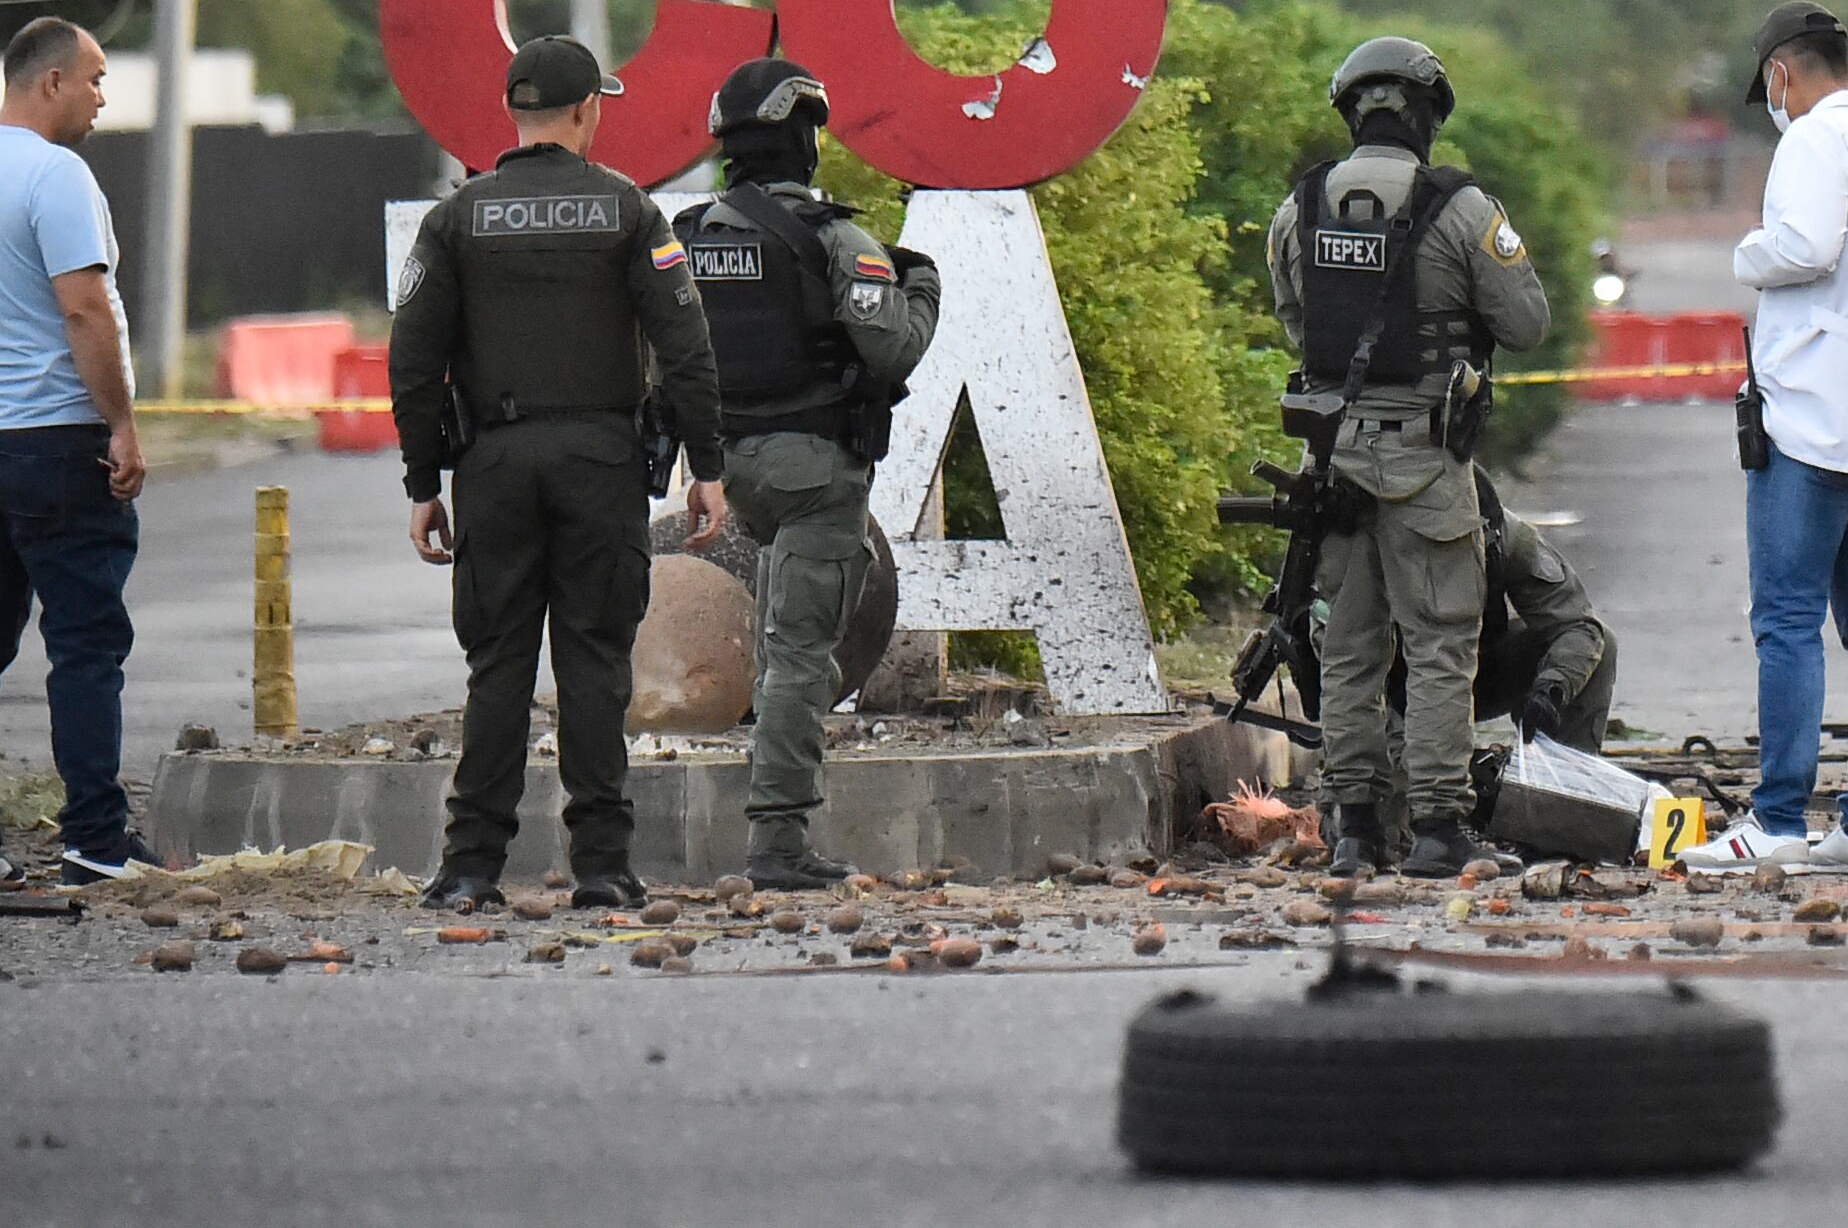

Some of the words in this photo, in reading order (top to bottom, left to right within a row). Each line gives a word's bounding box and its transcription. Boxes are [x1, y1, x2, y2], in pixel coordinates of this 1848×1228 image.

[482, 200, 607, 230] POLICIA
[1322, 237, 1377, 264] TEPEX
[1664, 808, 1685, 860] 2
